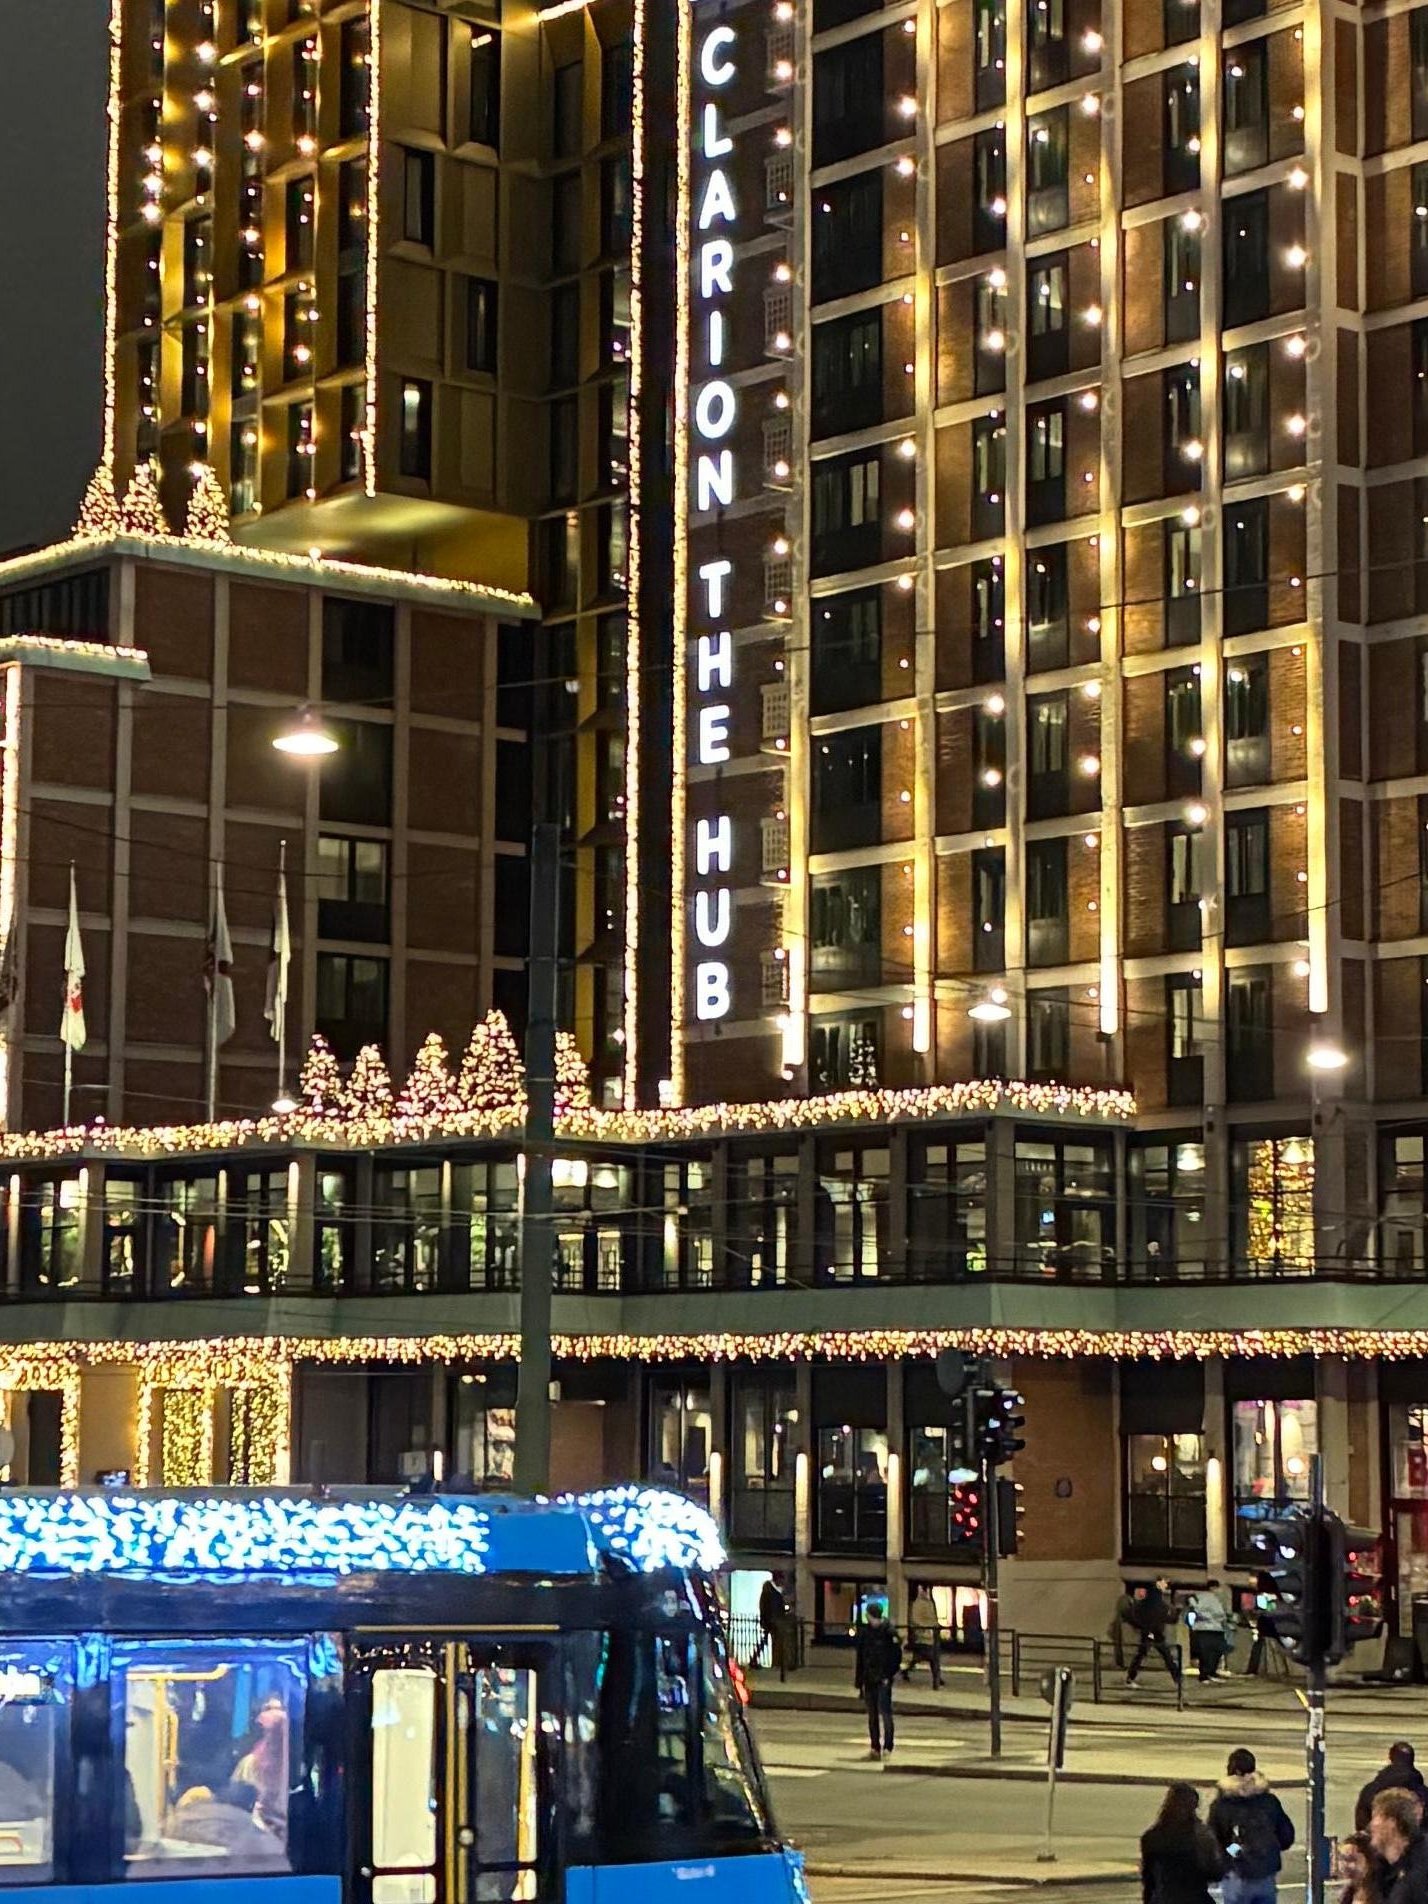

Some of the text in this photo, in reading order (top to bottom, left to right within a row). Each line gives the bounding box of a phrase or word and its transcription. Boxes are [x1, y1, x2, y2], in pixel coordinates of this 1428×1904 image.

[697, 25, 738, 513] CLARION
[697, 559, 733, 765] THE
[695, 814, 732, 1021] HUB
